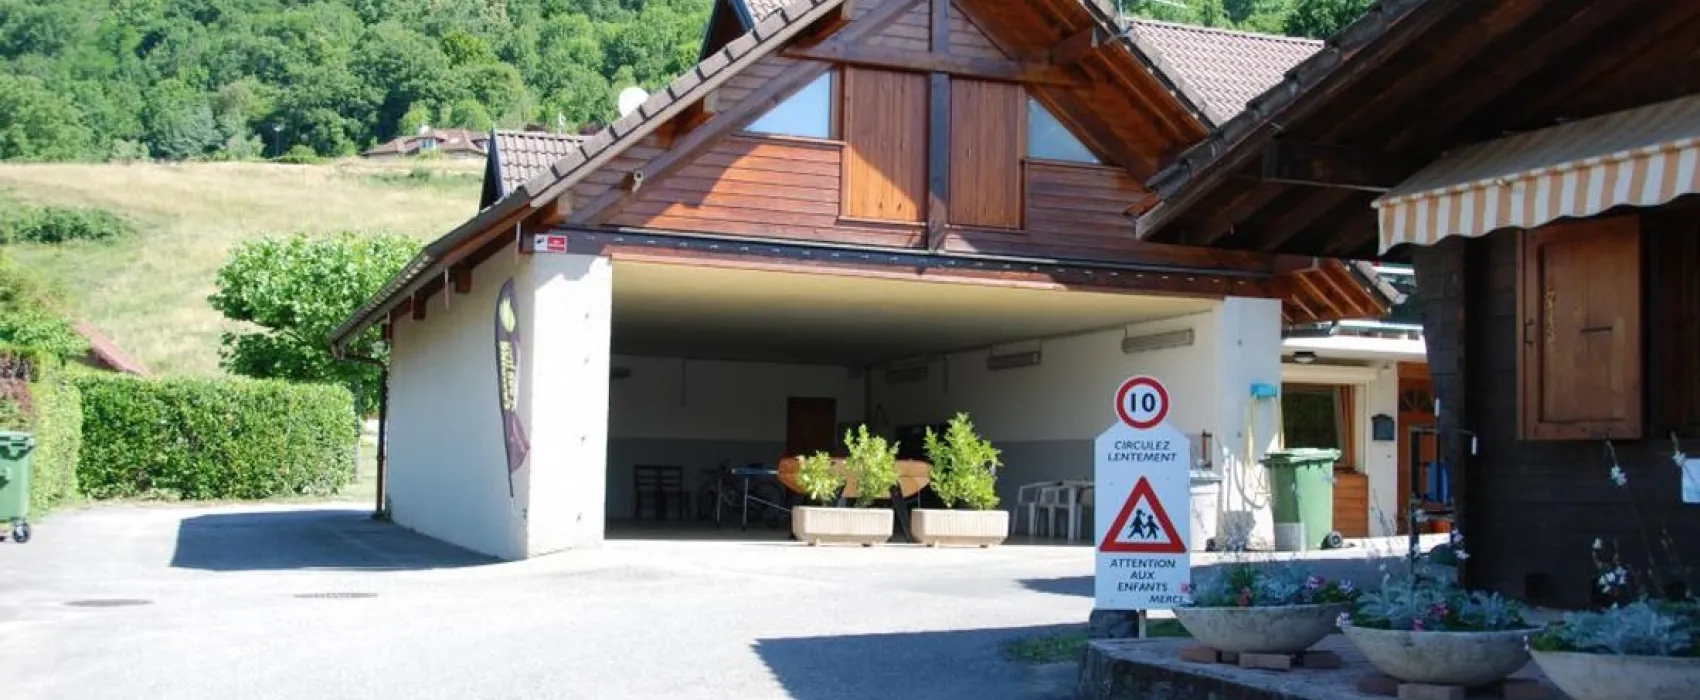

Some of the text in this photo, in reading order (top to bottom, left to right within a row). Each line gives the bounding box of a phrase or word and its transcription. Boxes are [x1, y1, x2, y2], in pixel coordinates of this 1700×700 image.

[1131, 393, 1156, 412] 10
[1114, 440, 1171, 450] CIRCULEZ
[1107, 452, 1176, 462] LENTEMENT
[1110, 559, 1176, 568] ATTENTION
[1130, 570, 1155, 579] AUX
[1118, 582, 1167, 592] ENFANTS
